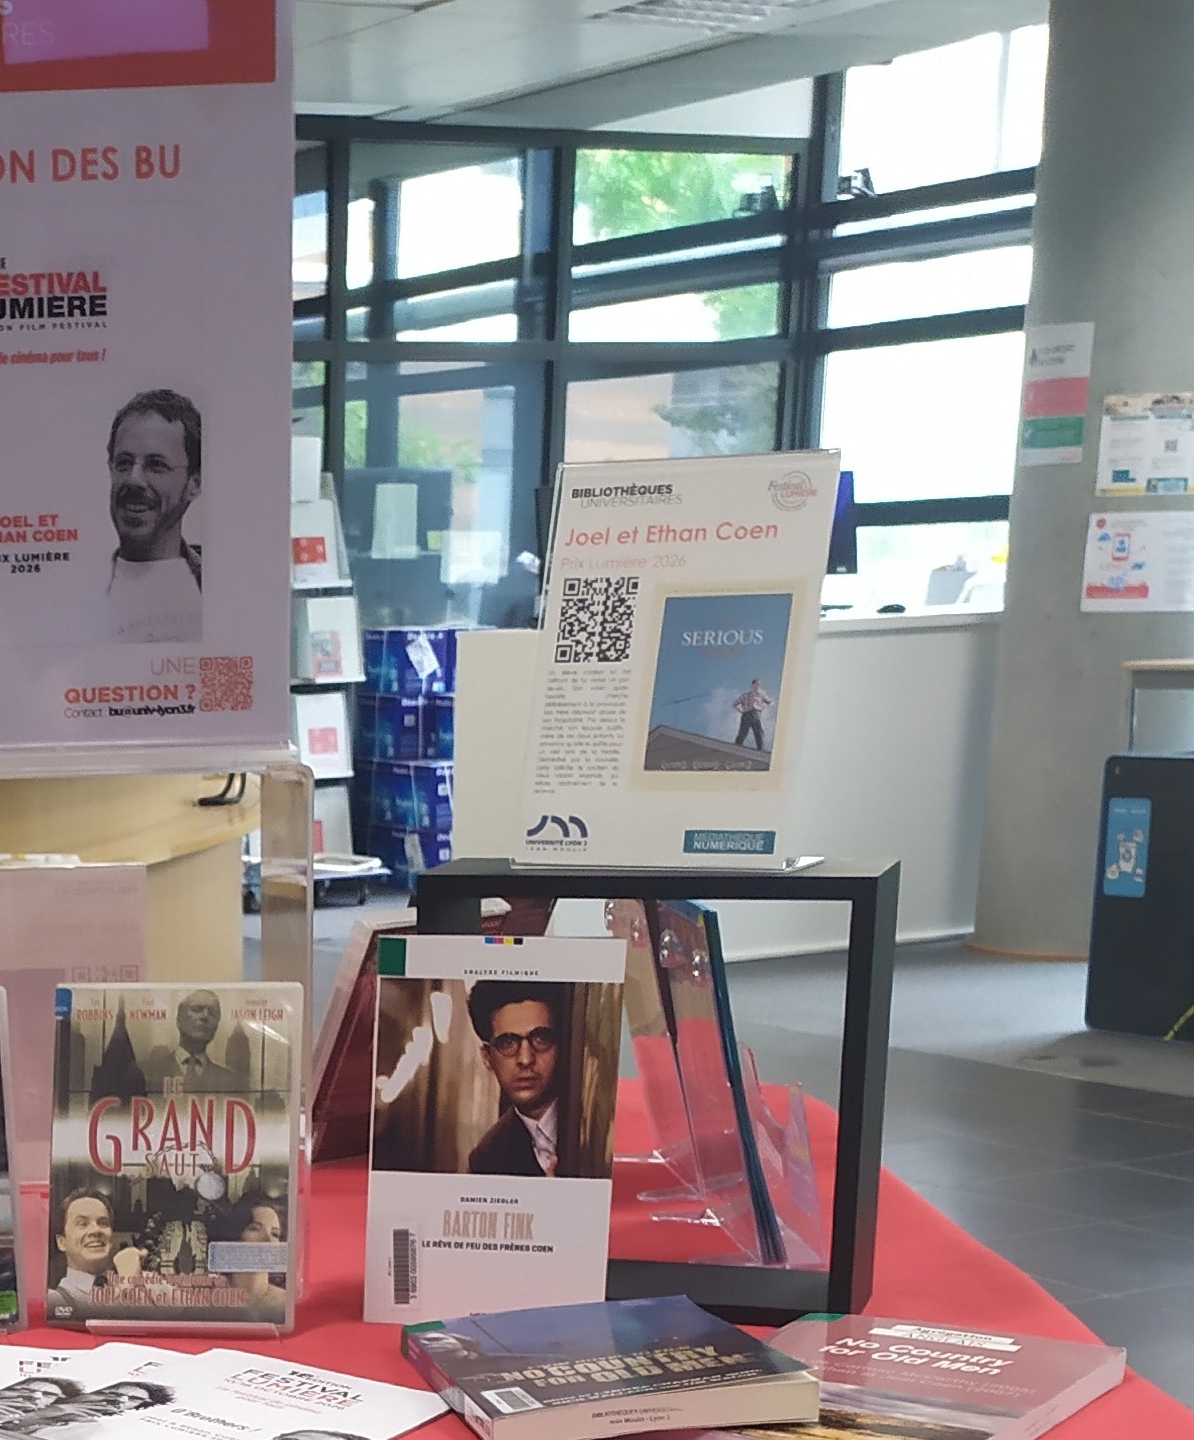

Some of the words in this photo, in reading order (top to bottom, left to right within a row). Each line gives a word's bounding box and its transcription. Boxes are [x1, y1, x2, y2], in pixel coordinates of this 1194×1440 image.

[51, 147, 120, 183] DES
[135, 144, 181, 179] BU
[19, 323, 46, 331] FILM
[52, 321, 108, 331] FESTIVAL
[571, 483, 673, 499] BIBLIOTHÈQUES
[38, 514, 59, 527] ET
[32, 528, 78, 542] COEN
[564, 528, 610, 547] Joel
[617, 527, 639, 545] et
[646, 524, 707, 543] Ethan
[716, 521, 778, 540] Coen
[15, 551, 70, 563] LUMIÈRE
[10, 564, 42, 574] 2026
[681, 629, 764, 647] SERIOUS
[150, 657, 196, 675] UNE
[64, 684, 179, 704] QUESTION
[64, 707, 102, 719] Contact
[129, 1009, 167, 1020] NEWMAN
[230, 1009, 256, 1020] JASON
[258, 1009, 284, 1020] LEIGH
[87, 1097, 257, 1176] GRAND
[144, 1152, 200, 1177] SAUT
[459, 1196, 488, 1204] DAMIEN
[442, 1209, 498, 1238] BARTON
[504, 1212, 535, 1241] FINK
[421, 1239, 432, 1247] LE
[433, 1238, 453, 1248] RÊVE
[454, 1241, 465, 1249] DE
[465, 1241, 481, 1250] FEU
[482, 1243, 498, 1251] DES
[499, 1241, 531, 1252] FRÈRES
[532, 1245, 554, 1253] COEN
[820, 1345, 868, 1357] for
[871, 1351, 930, 1366] Old
[932, 1357, 1002, 1376] Men
[836, 1337, 880, 1350] No
[888, 1343, 1014, 1368] Country
[243, 1368, 364, 1402] FESTIVAL
